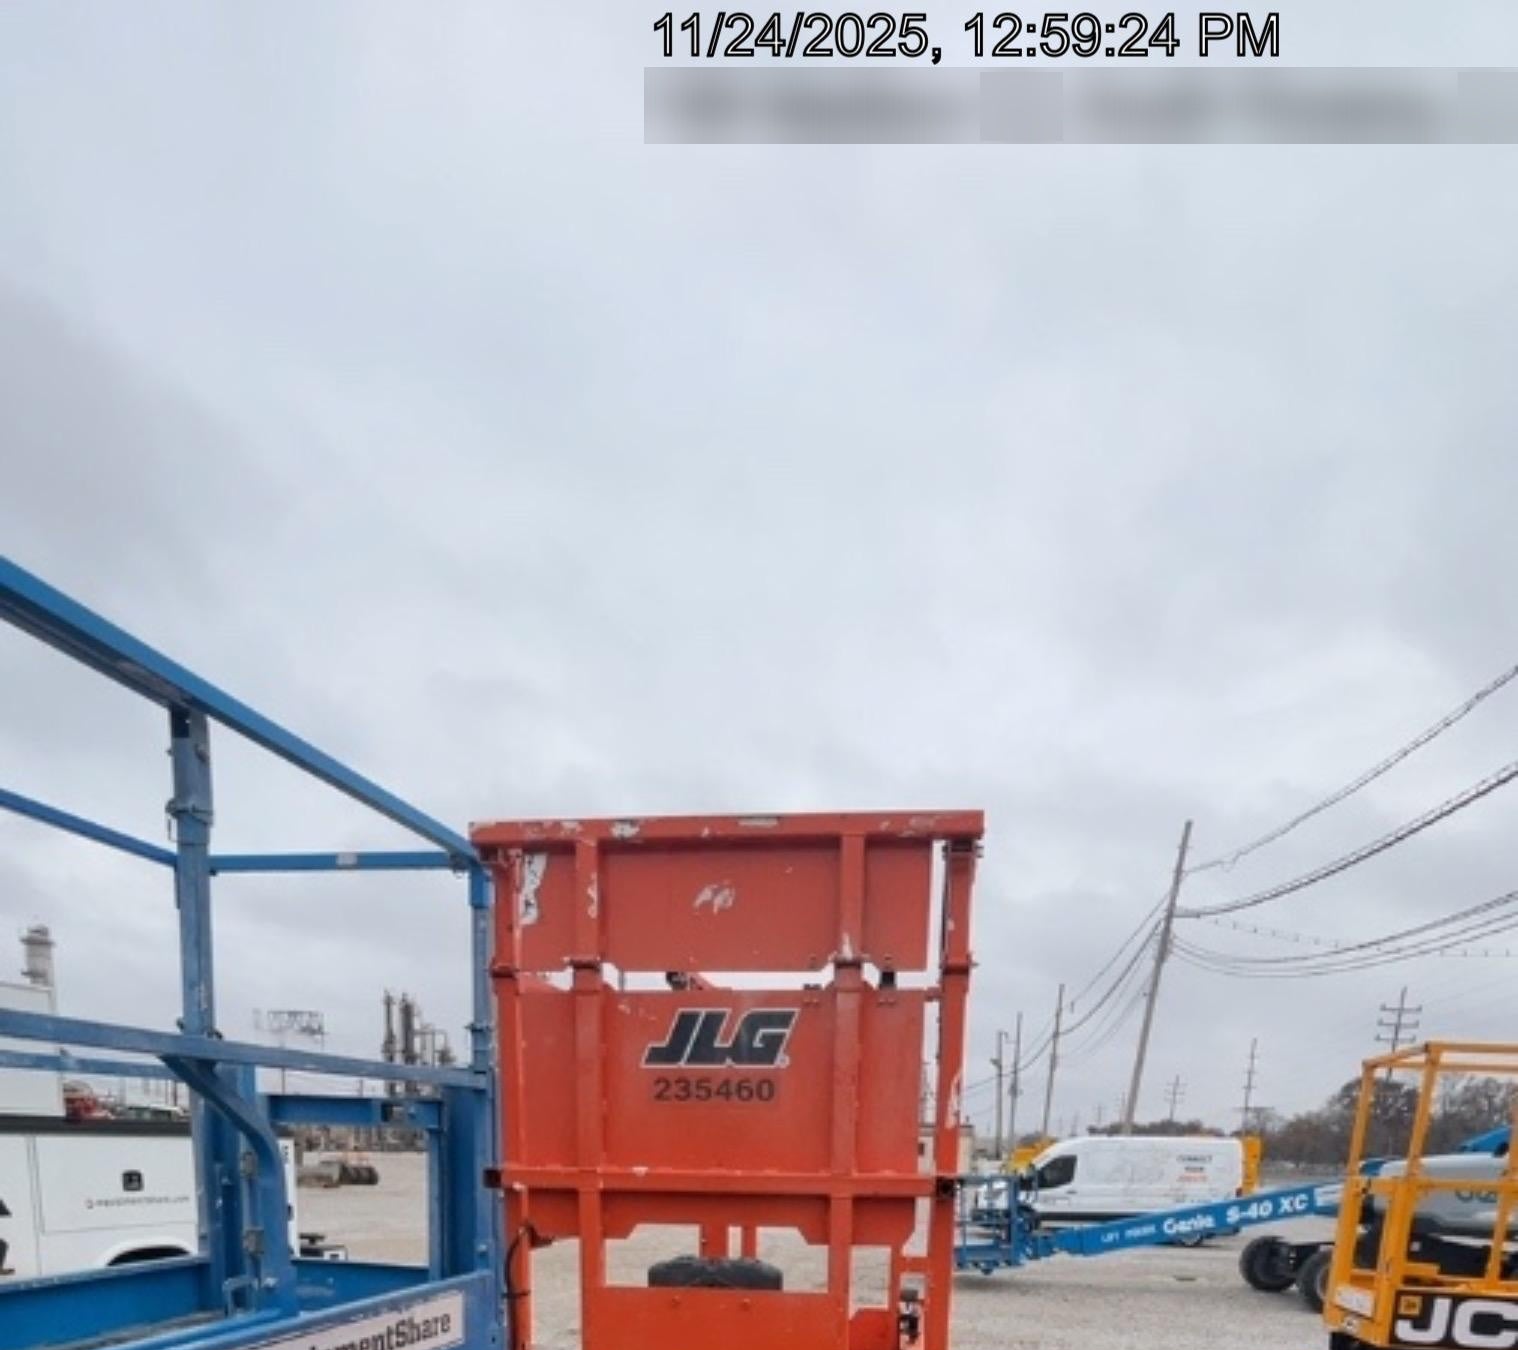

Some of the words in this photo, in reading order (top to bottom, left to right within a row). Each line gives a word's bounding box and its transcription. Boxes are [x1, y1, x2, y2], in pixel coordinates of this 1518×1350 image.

[640, 1008, 799, 1068] JLG
[654, 1076, 776, 1102] 235460
[1226, 1200, 1273, 1224] S-40
[1278, 1194, 1309, 1214] XC
[1162, 1214, 1216, 1235] Genie
